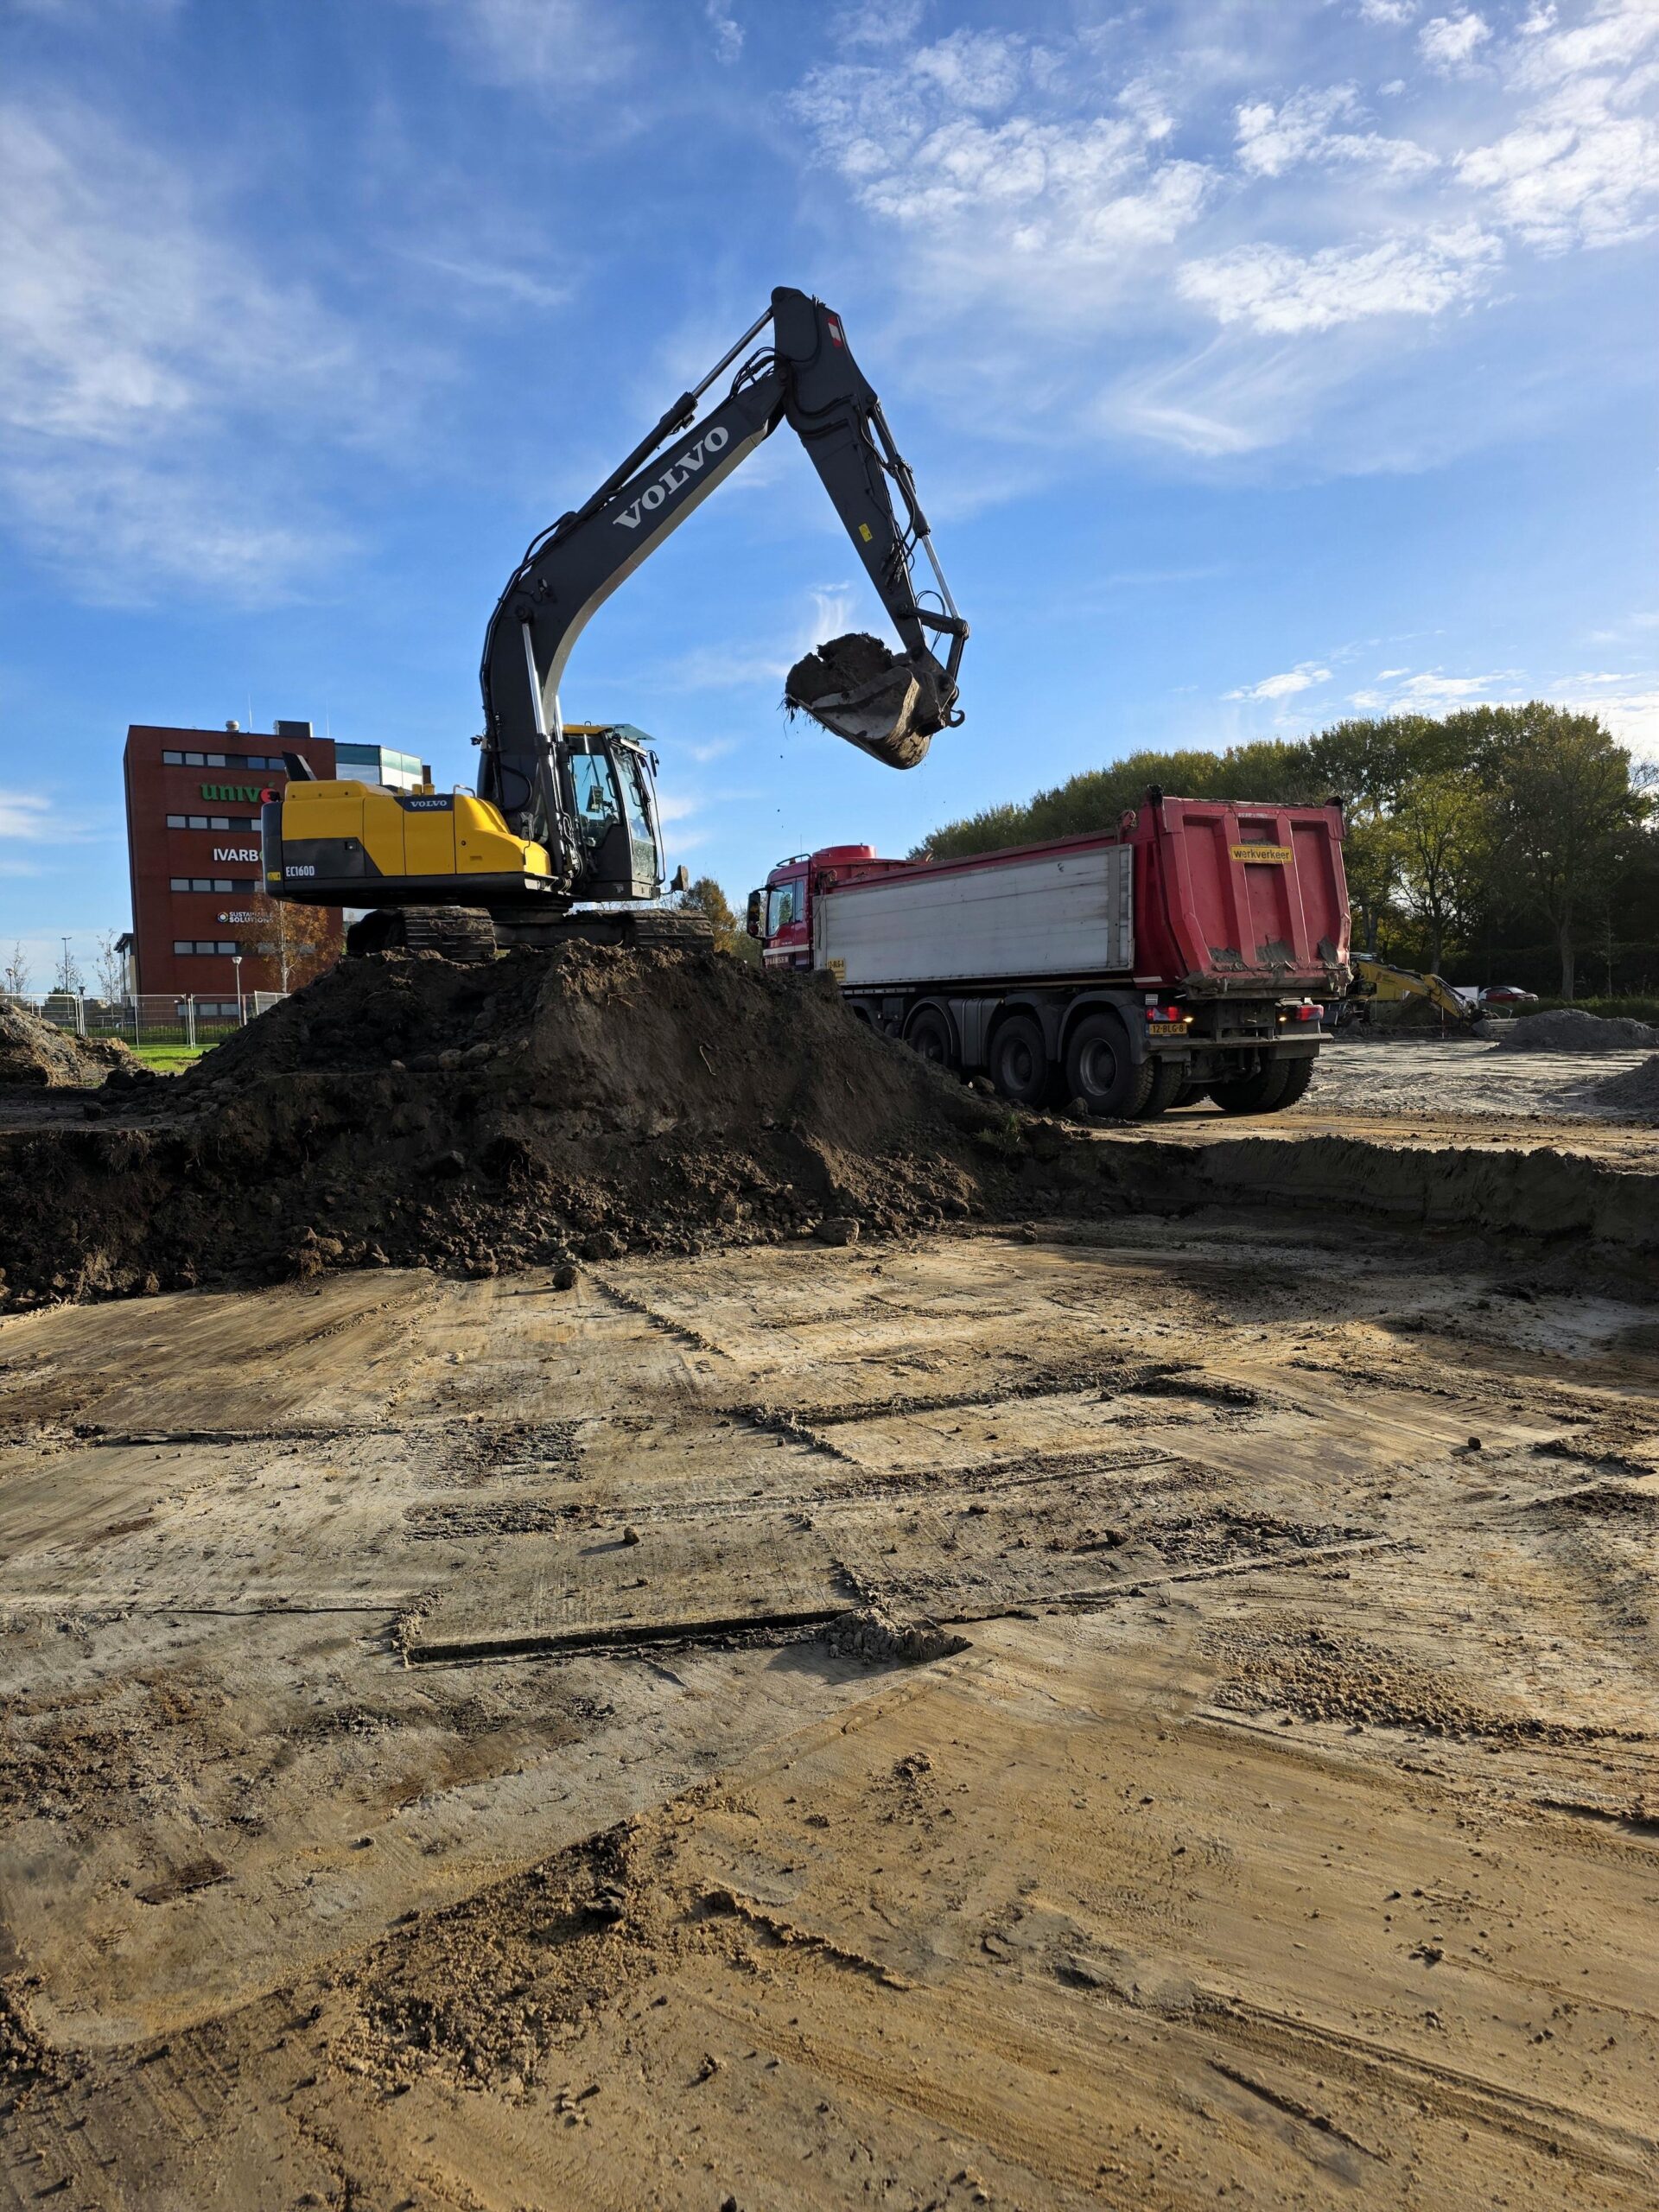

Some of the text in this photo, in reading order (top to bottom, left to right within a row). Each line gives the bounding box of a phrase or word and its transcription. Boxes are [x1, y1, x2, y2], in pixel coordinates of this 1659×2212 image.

[613, 426, 728, 529] VOLVO
[213, 849, 263, 861] IVARB
[1234, 849, 1289, 860] werkverkeer
[285, 866, 315, 877] EC160D
[1152, 1024, 1185, 1033] 12-BLG-8
